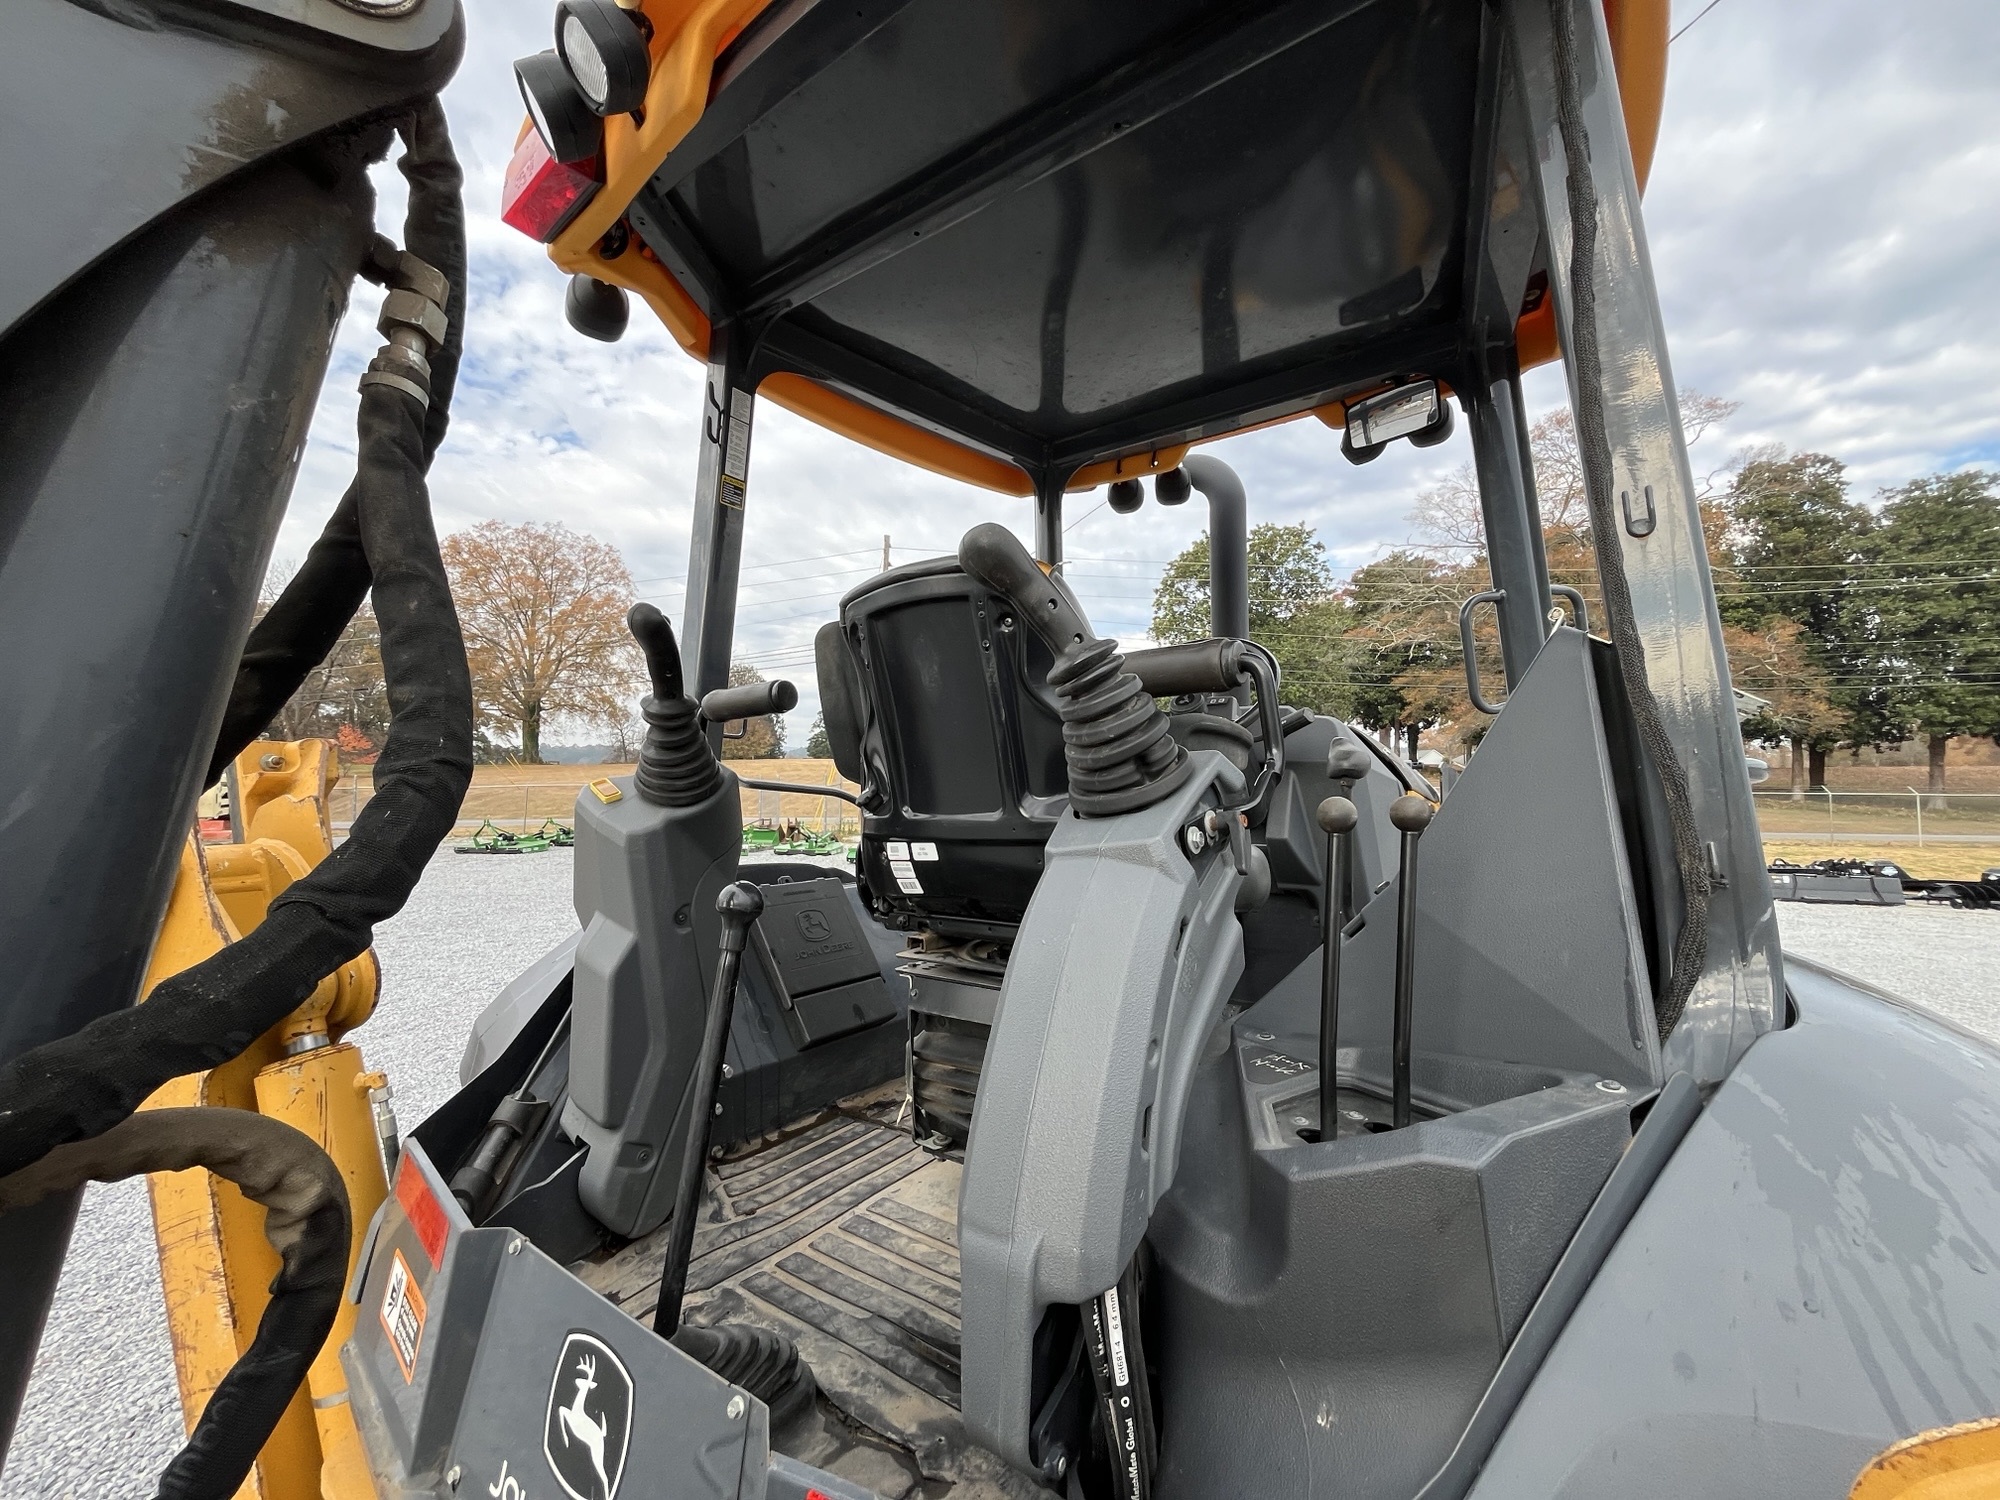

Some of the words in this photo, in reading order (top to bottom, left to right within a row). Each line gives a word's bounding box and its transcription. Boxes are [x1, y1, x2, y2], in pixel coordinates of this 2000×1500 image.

[795, 947, 822, 960] JOHN
[823, 942, 854, 953] DEERE
[1125, 1417, 1135, 1450] Global
[489, 1459, 526, 1500] JO
